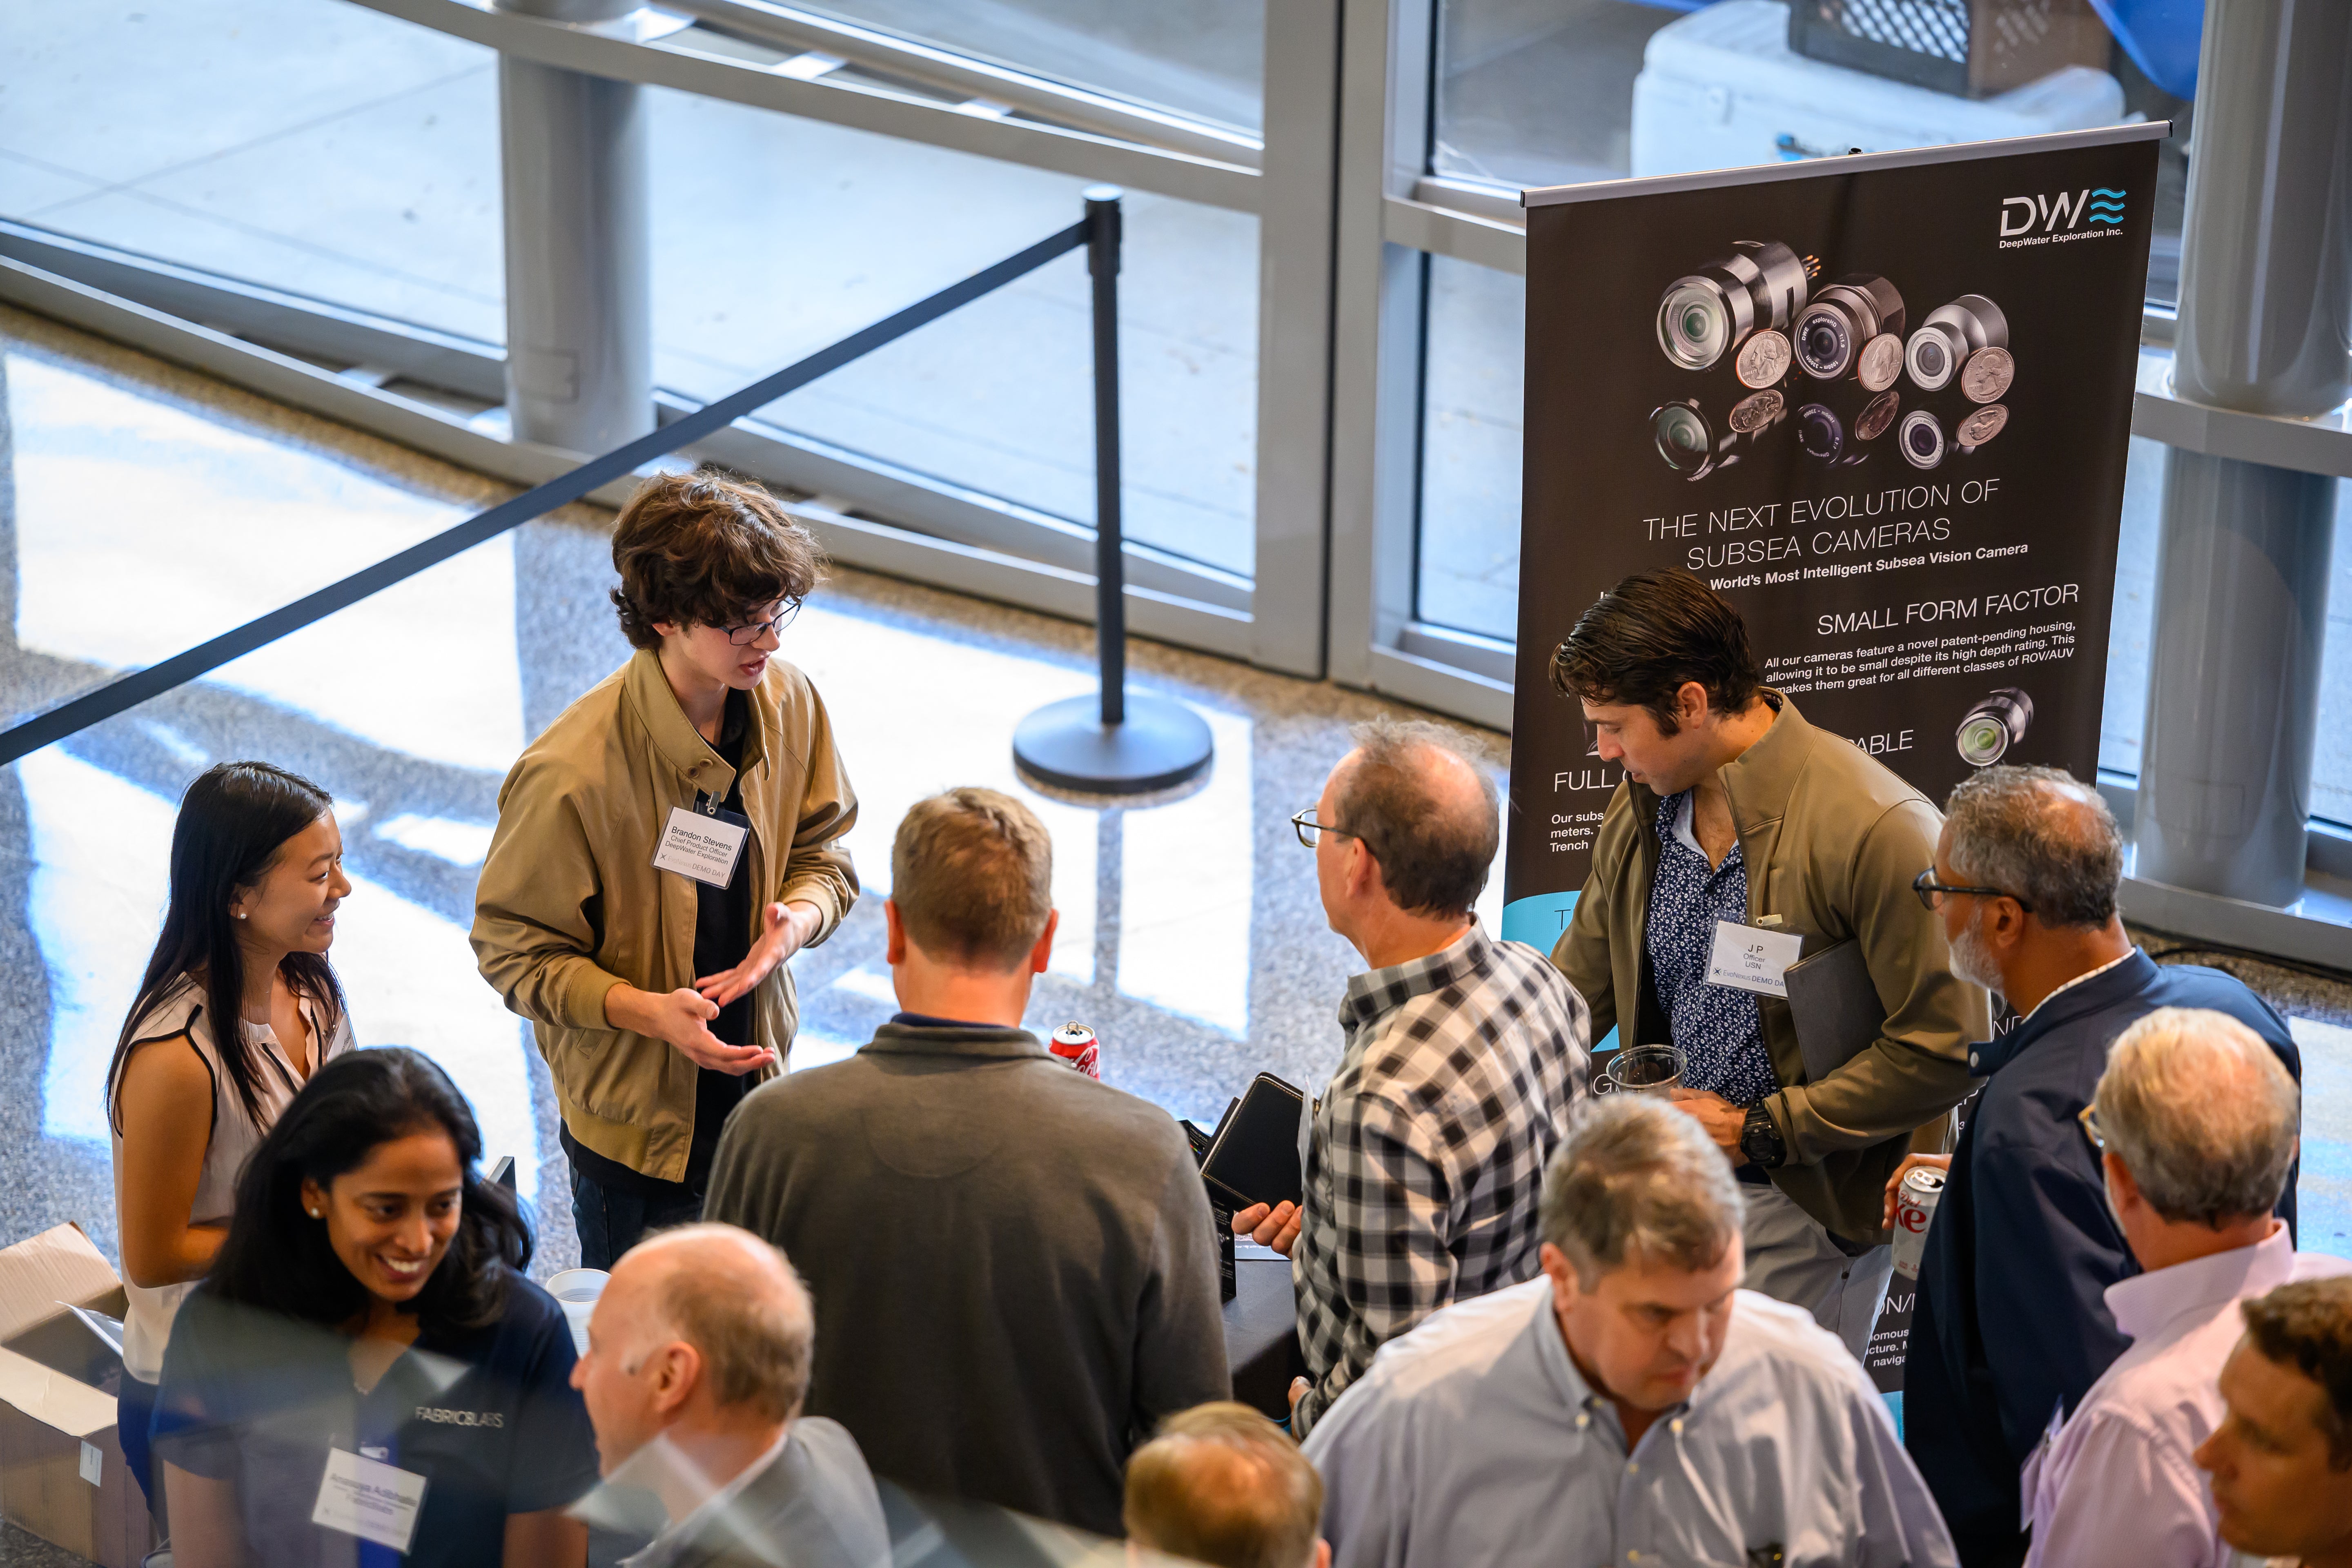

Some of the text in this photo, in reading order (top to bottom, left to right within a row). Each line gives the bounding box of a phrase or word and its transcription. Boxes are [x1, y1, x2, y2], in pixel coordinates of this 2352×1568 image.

[1999, 236, 2050, 249] DeepWater
[2052, 230, 2104, 242] Exploration
[1812, 316, 1837, 327] exploreHD
[1805, 354, 1819, 369] 3300ft
[1824, 361, 1838, 370] 1000m
[1643, 479, 2000, 540] THE NEXT EVOLUTION OF
[1687, 518, 1950, 570] SUBSEA CAMERAS
[1710, 544, 2028, 590] World's Most Intelligent Subsea Vision Camera
[1817, 584, 2079, 635] SMALL FORM FACTOR
[1765, 621, 2076, 669] All our cameras feature a novel patent-pending housing,
[1766, 634, 2075, 682] allowing it to be small despite its high depth rating. This
[1775, 648, 2074, 694] makes them great for all different classes of ROV/AUV
[1554, 769, 1615, 792] FULL
[1551, 811, 1604, 824] Our subs
[671, 826, 733, 851] Brandon Stevens
[1550, 827, 1593, 838] meters.
[665, 840, 729, 865] DeepWater Exploration
[670, 835, 728, 858] Chief Product Officer
[1550, 840, 1588, 852] Trench
[692, 863, 711, 874] DEMO
[712, 869, 726, 878] DAY
[1743, 953, 1765, 963] Officer
[1756, 945, 1763, 953] P
[1745, 961, 1761, 970] USN
[1752, 976, 1773, 985] DEMO
[1900, 1190, 1921, 1208] Diet
